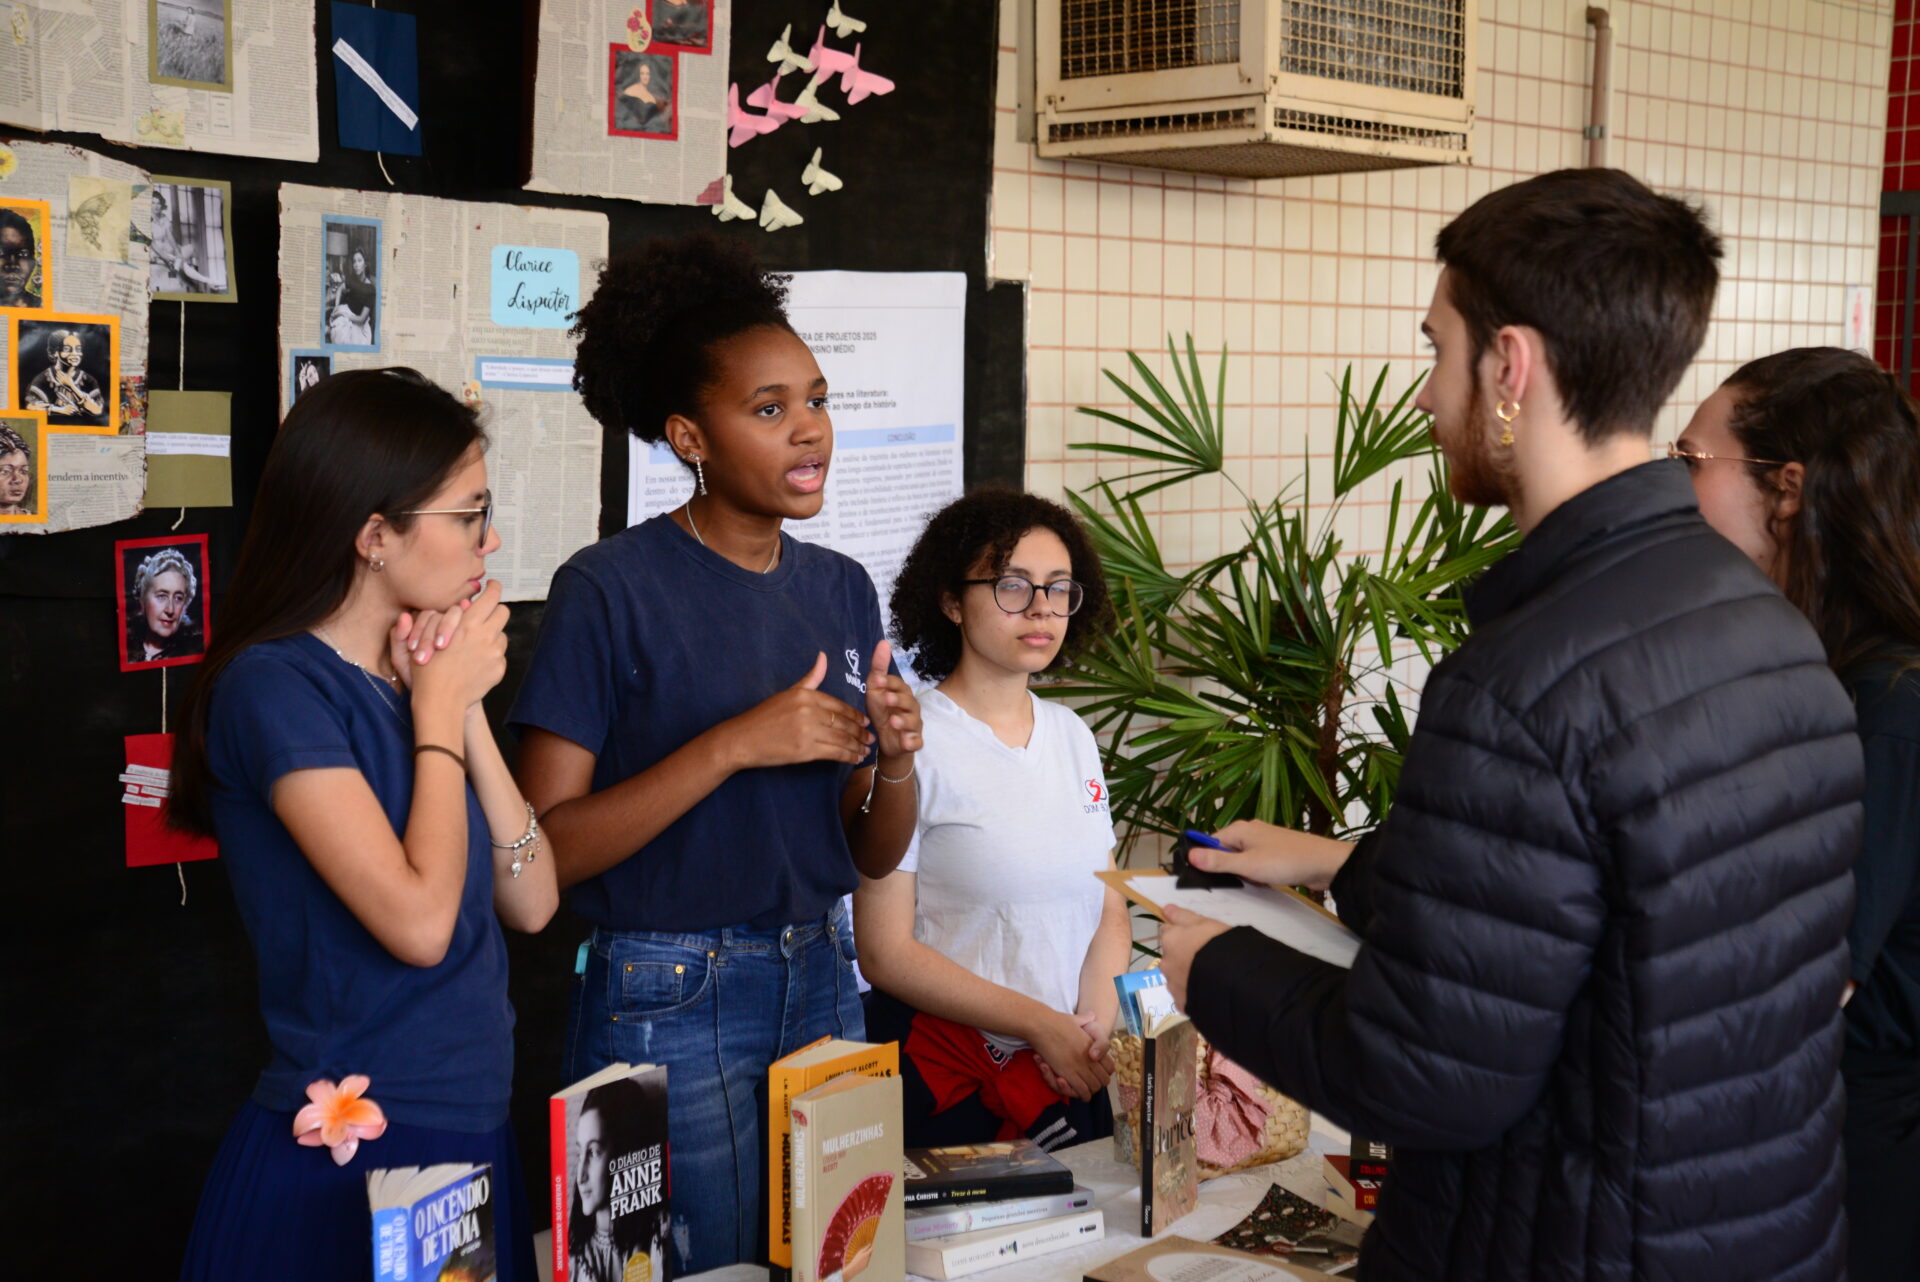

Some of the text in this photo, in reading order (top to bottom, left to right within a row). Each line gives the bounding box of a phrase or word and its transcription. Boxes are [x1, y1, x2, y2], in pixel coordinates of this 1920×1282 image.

[504, 250, 553, 273] Clarice
[809, 345, 831, 354] NSINO
[814, 332, 823, 341] DE
[825, 332, 861, 341] PROJETOS
[858, 1060, 879, 1072] ALCOTT
[822, 1122, 884, 1154] MULHERZINHAS
[609, 1144, 661, 1172] O DIÁRIO DE
[610, 1159, 662, 1198] ANNE
[610, 1185, 662, 1220] FRANK
[415, 1207, 426, 1240] O
[422, 1231, 440, 1268] DE
